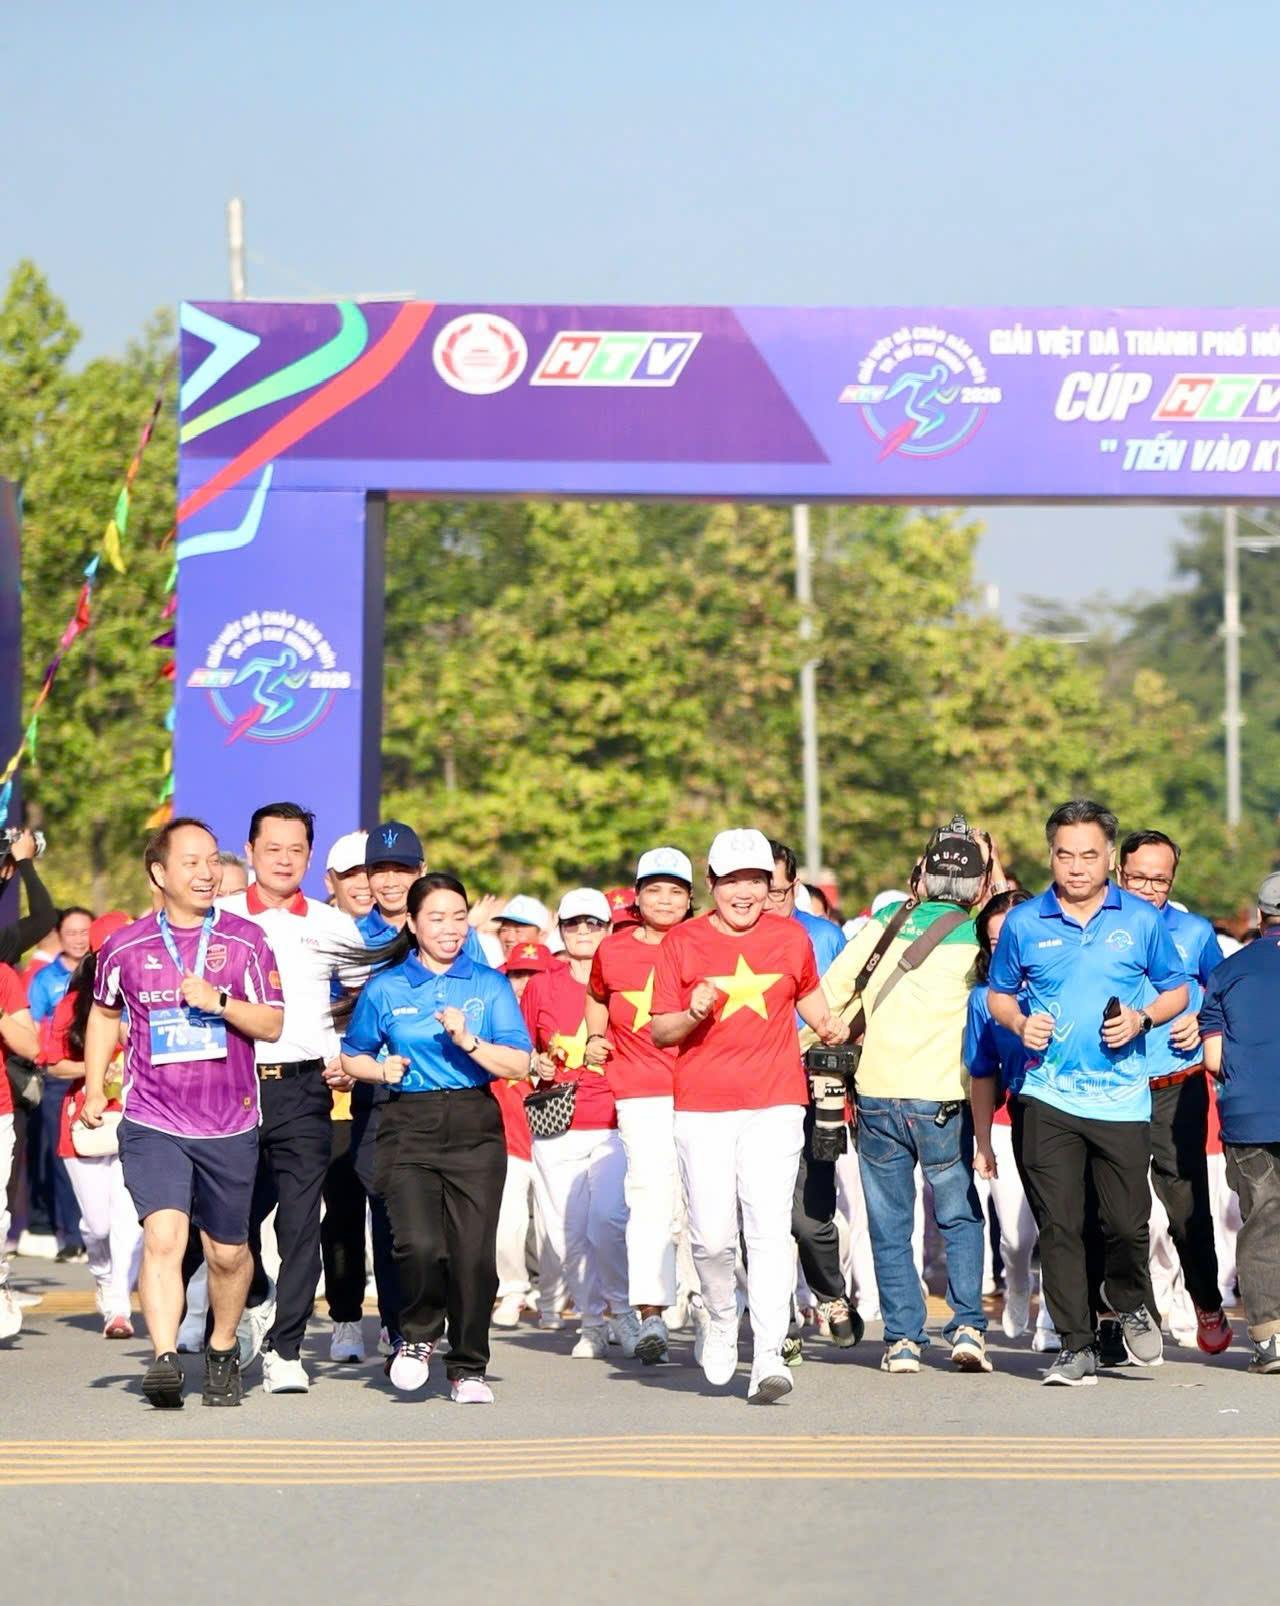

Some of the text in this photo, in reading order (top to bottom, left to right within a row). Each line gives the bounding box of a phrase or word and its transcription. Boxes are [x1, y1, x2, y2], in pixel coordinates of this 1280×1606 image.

[537, 337, 694, 381] HTV
[1054, 364, 1153, 422] CÚP
[1121, 431, 1187, 472] TIẾN
[1190, 433, 1252, 473] VÀO
[866, 953, 881, 972] EOS
[139, 984, 233, 1004] BECX
